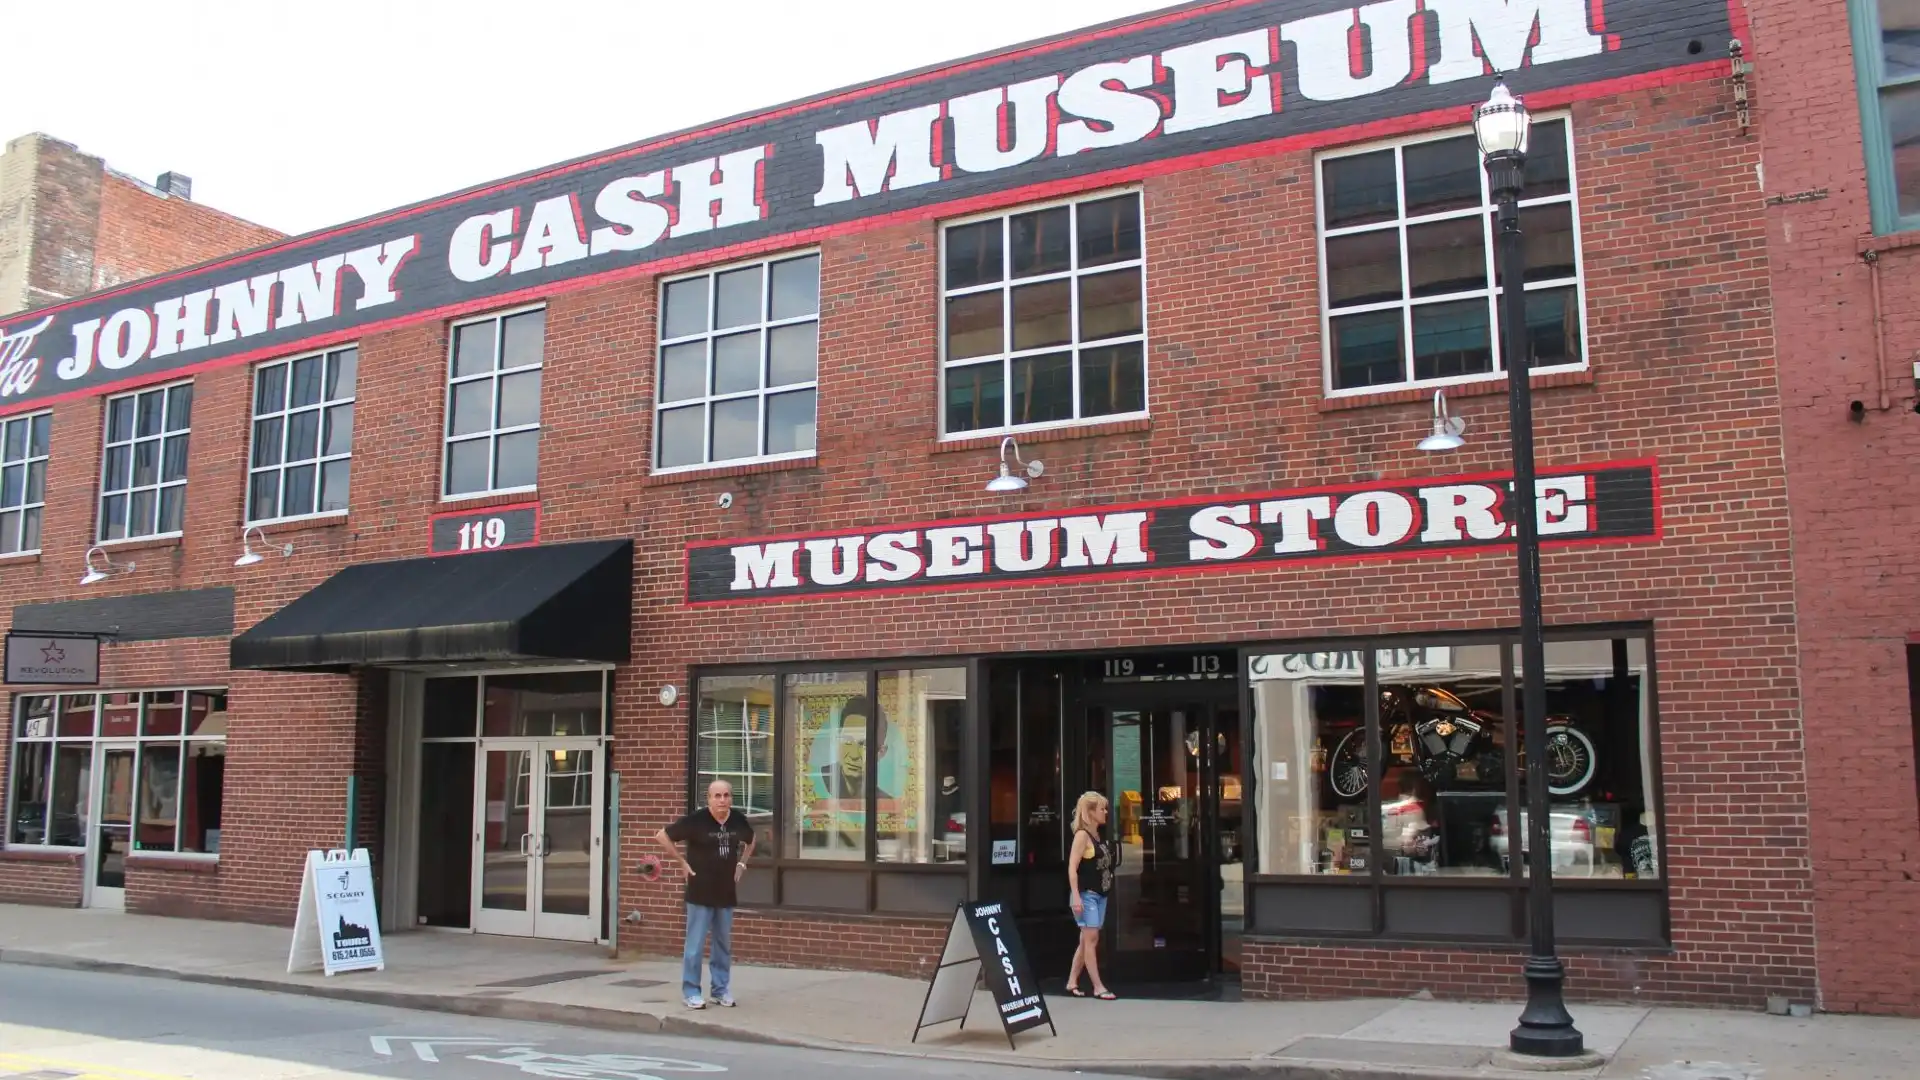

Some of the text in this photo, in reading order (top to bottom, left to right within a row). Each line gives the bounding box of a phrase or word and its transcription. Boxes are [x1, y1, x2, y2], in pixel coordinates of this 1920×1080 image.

[0, 0, 1603, 397] The JOHNNY CASH MUSEUM
[458, 517, 505, 551] 119
[730, 475, 1589, 591] MUSEUM STORE
[1105, 659, 1135, 677] 119
[1192, 655, 1220, 672] 113
[975, 903, 1002, 918] JOHNNY
[336, 937, 369, 947] TOURS
[988, 917, 1022, 996] CASH
[1001, 994, 1040, 1012] MUSEUM OPEN
